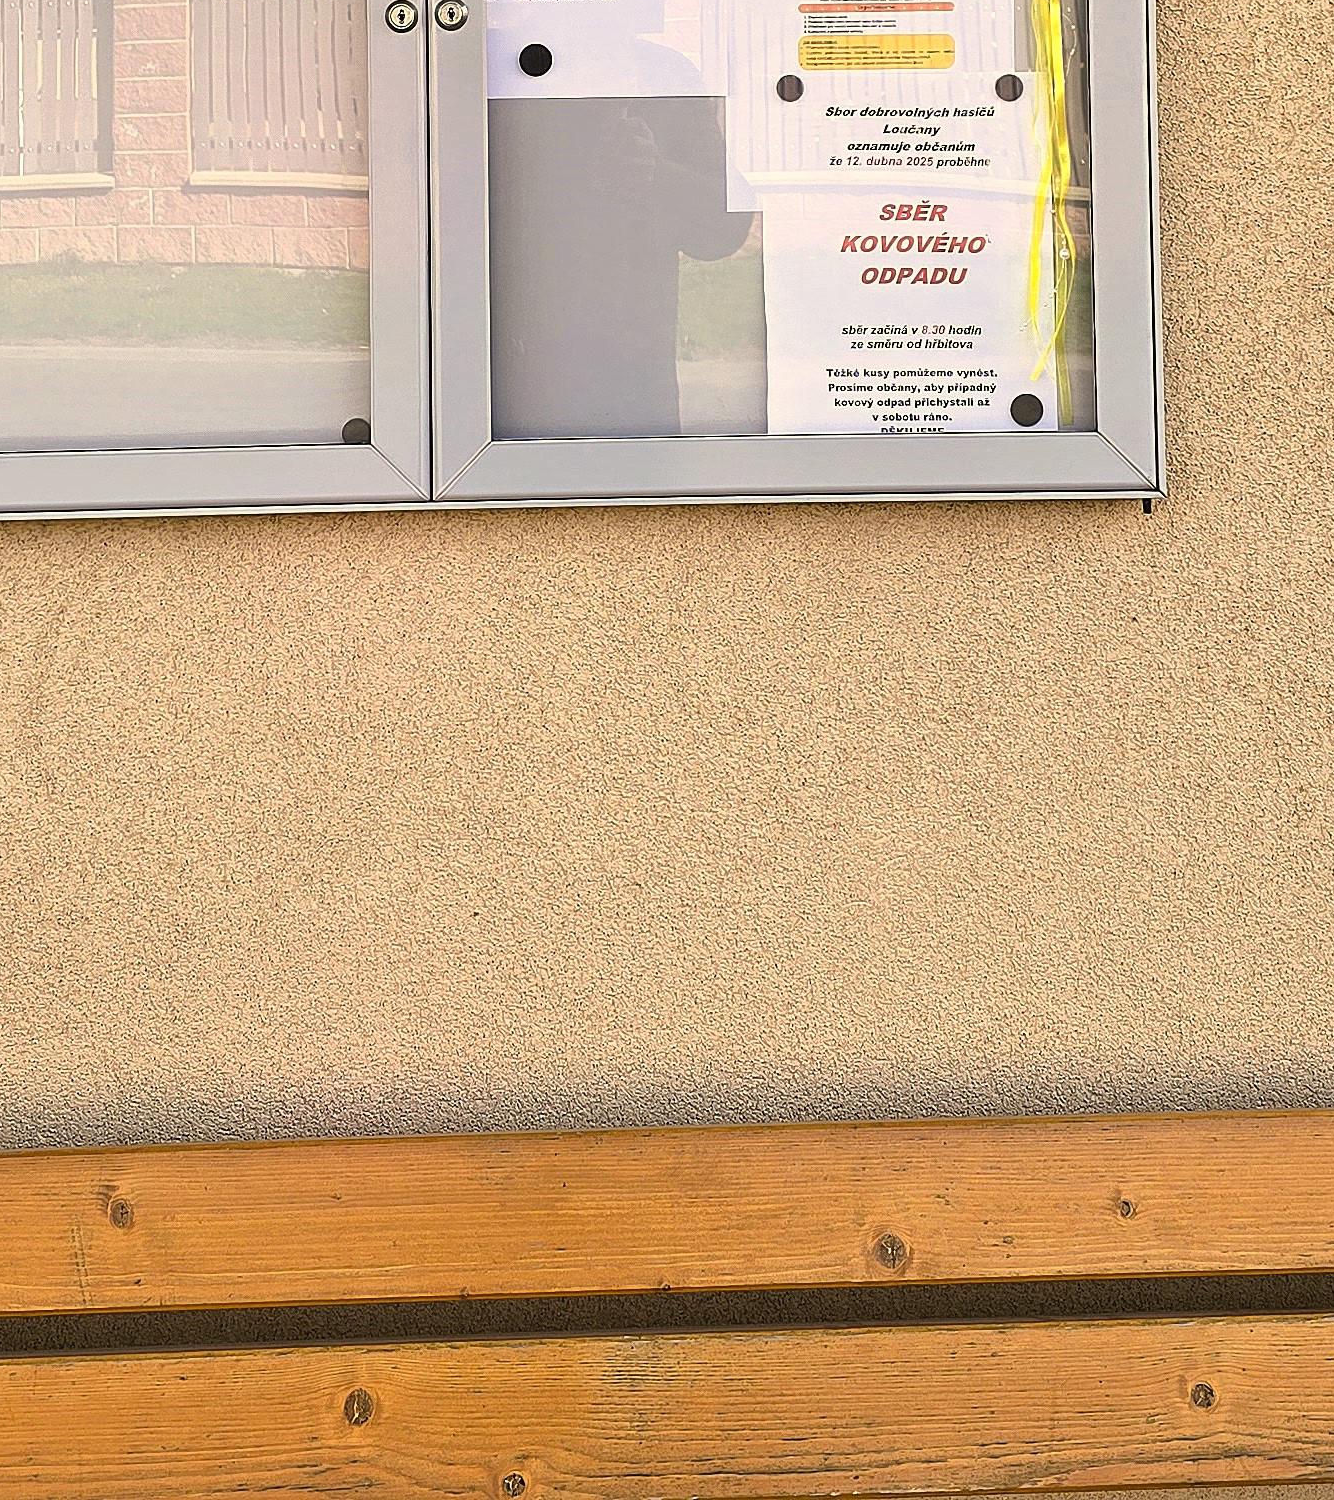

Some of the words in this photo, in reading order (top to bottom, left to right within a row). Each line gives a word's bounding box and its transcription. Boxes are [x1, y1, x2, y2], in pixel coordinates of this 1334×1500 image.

[826, 106, 857, 117] Sbor
[860, 106, 949, 119] dobrovolných
[883, 124, 941, 137] Loučany
[847, 142, 911, 153] oznamuje
[829, 156, 842, 166] že
[847, 156, 862, 166] 12.
[866, 156, 903, 166] dubna
[906, 156, 934, 167] 2025
[936, 156, 991, 169] proběhne
[879, 200, 948, 222] SBĚR
[840, 232, 986, 254] KOVOVÉHO
[861, 267, 968, 285] ODPADU
[842, 325, 868, 336] sběr
[870, 325, 908, 337] začíná
[911, 327, 919, 335] v
[922, 325, 946, 335] 8.30
[948, 325, 982, 335] hodin
[851, 341, 864, 350] ze
[867, 339, 903, 350] směru
[906, 338, 923, 350] od
[925, 338, 973, 350] hřbitova
[826, 367, 860, 378] Těžké
[863, 368, 890, 379] kusy
[893, 367, 954, 379] pomůžeme
[956, 367, 998, 379] vynést.
[828, 382, 873, 392] Prosíme
[876, 382, 921, 394] občany,
[924, 383, 944, 394] aby
[947, 382, 997, 394] případný
[834, 397, 874, 409] kovový
[876, 397, 911, 409] odpad
[914, 397, 974, 409] přichystali
[977, 397, 990, 407] až
[882, 413, 920, 421] sobotu
[923, 412, 953, 421] ráno.
